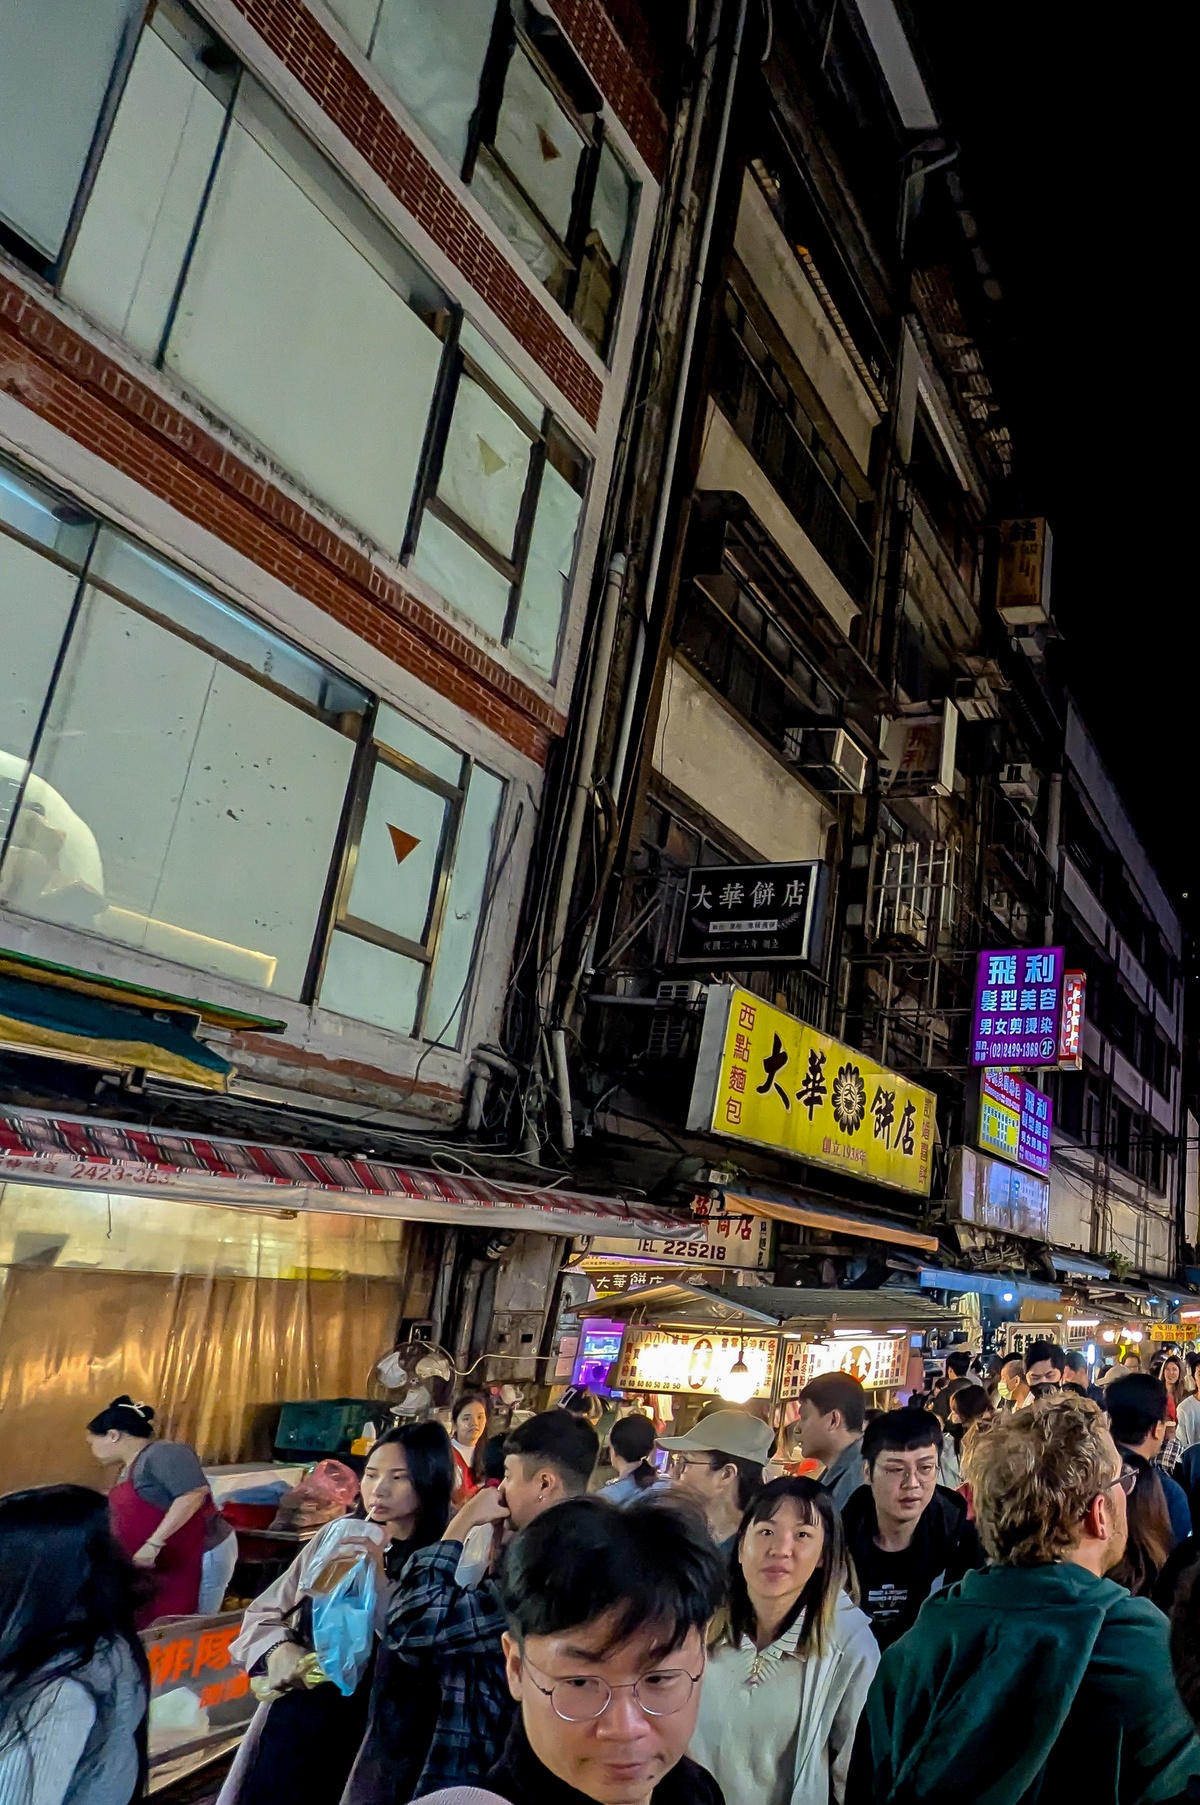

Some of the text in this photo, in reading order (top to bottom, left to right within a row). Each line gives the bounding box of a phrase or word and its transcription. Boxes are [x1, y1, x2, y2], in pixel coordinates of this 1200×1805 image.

[690, 880, 806, 910] 大華餅店
[988, 954, 1055, 985] 飛利
[980, 988, 1057, 1011] 髮型美容
[725, 1002, 757, 1125] 西點麵包
[756, 1032, 917, 1155] 大華餅店
[70, 1163, 174, 1186] 2423-363
[663, 1241, 727, 1260] 225218
